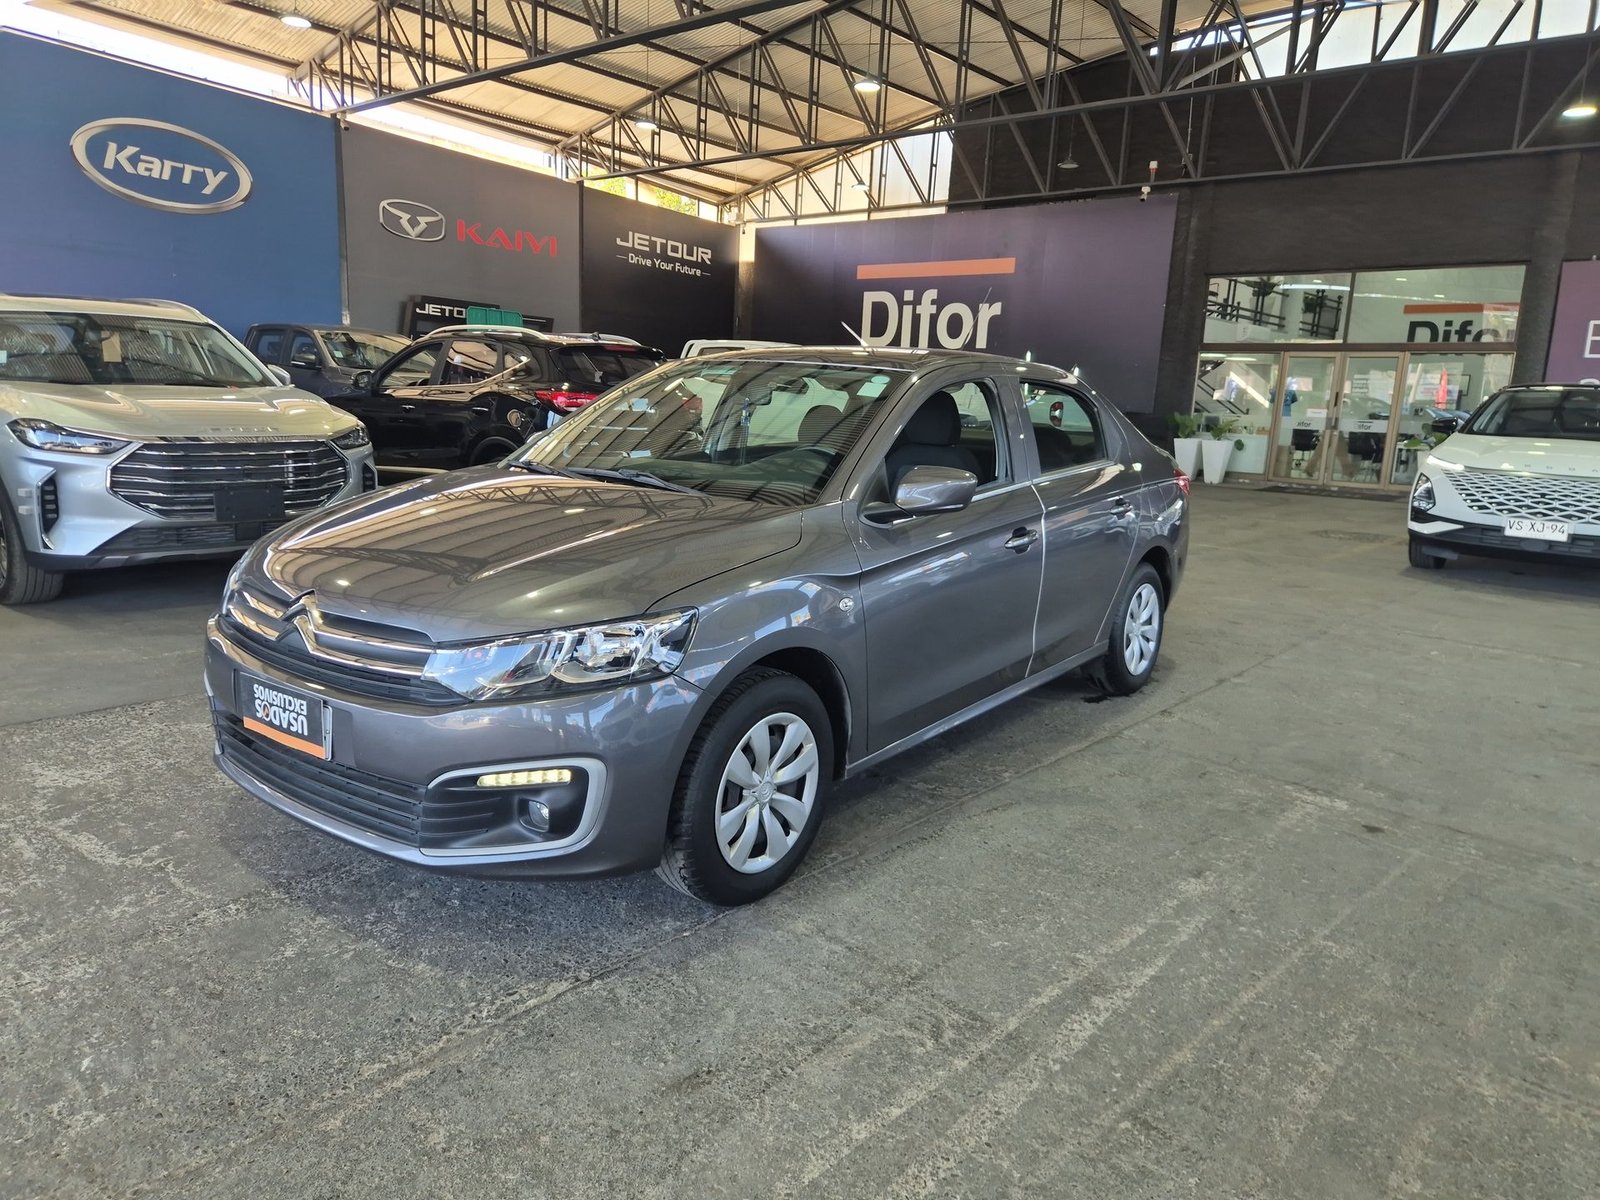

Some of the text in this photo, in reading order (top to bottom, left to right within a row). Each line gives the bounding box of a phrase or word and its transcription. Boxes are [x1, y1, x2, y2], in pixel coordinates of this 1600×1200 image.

[103, 141, 228, 195] Karry
[616, 231, 712, 265] JETOUR
[628, 253, 701, 277] Drive Your Future
[416, 303, 466, 319] JETO
[861, 288, 1002, 350] Difor
[1508, 519, 1524, 531] VS
[253, 683, 308, 716] EXCLUSIVOS
[254, 698, 308, 736] USADOS
